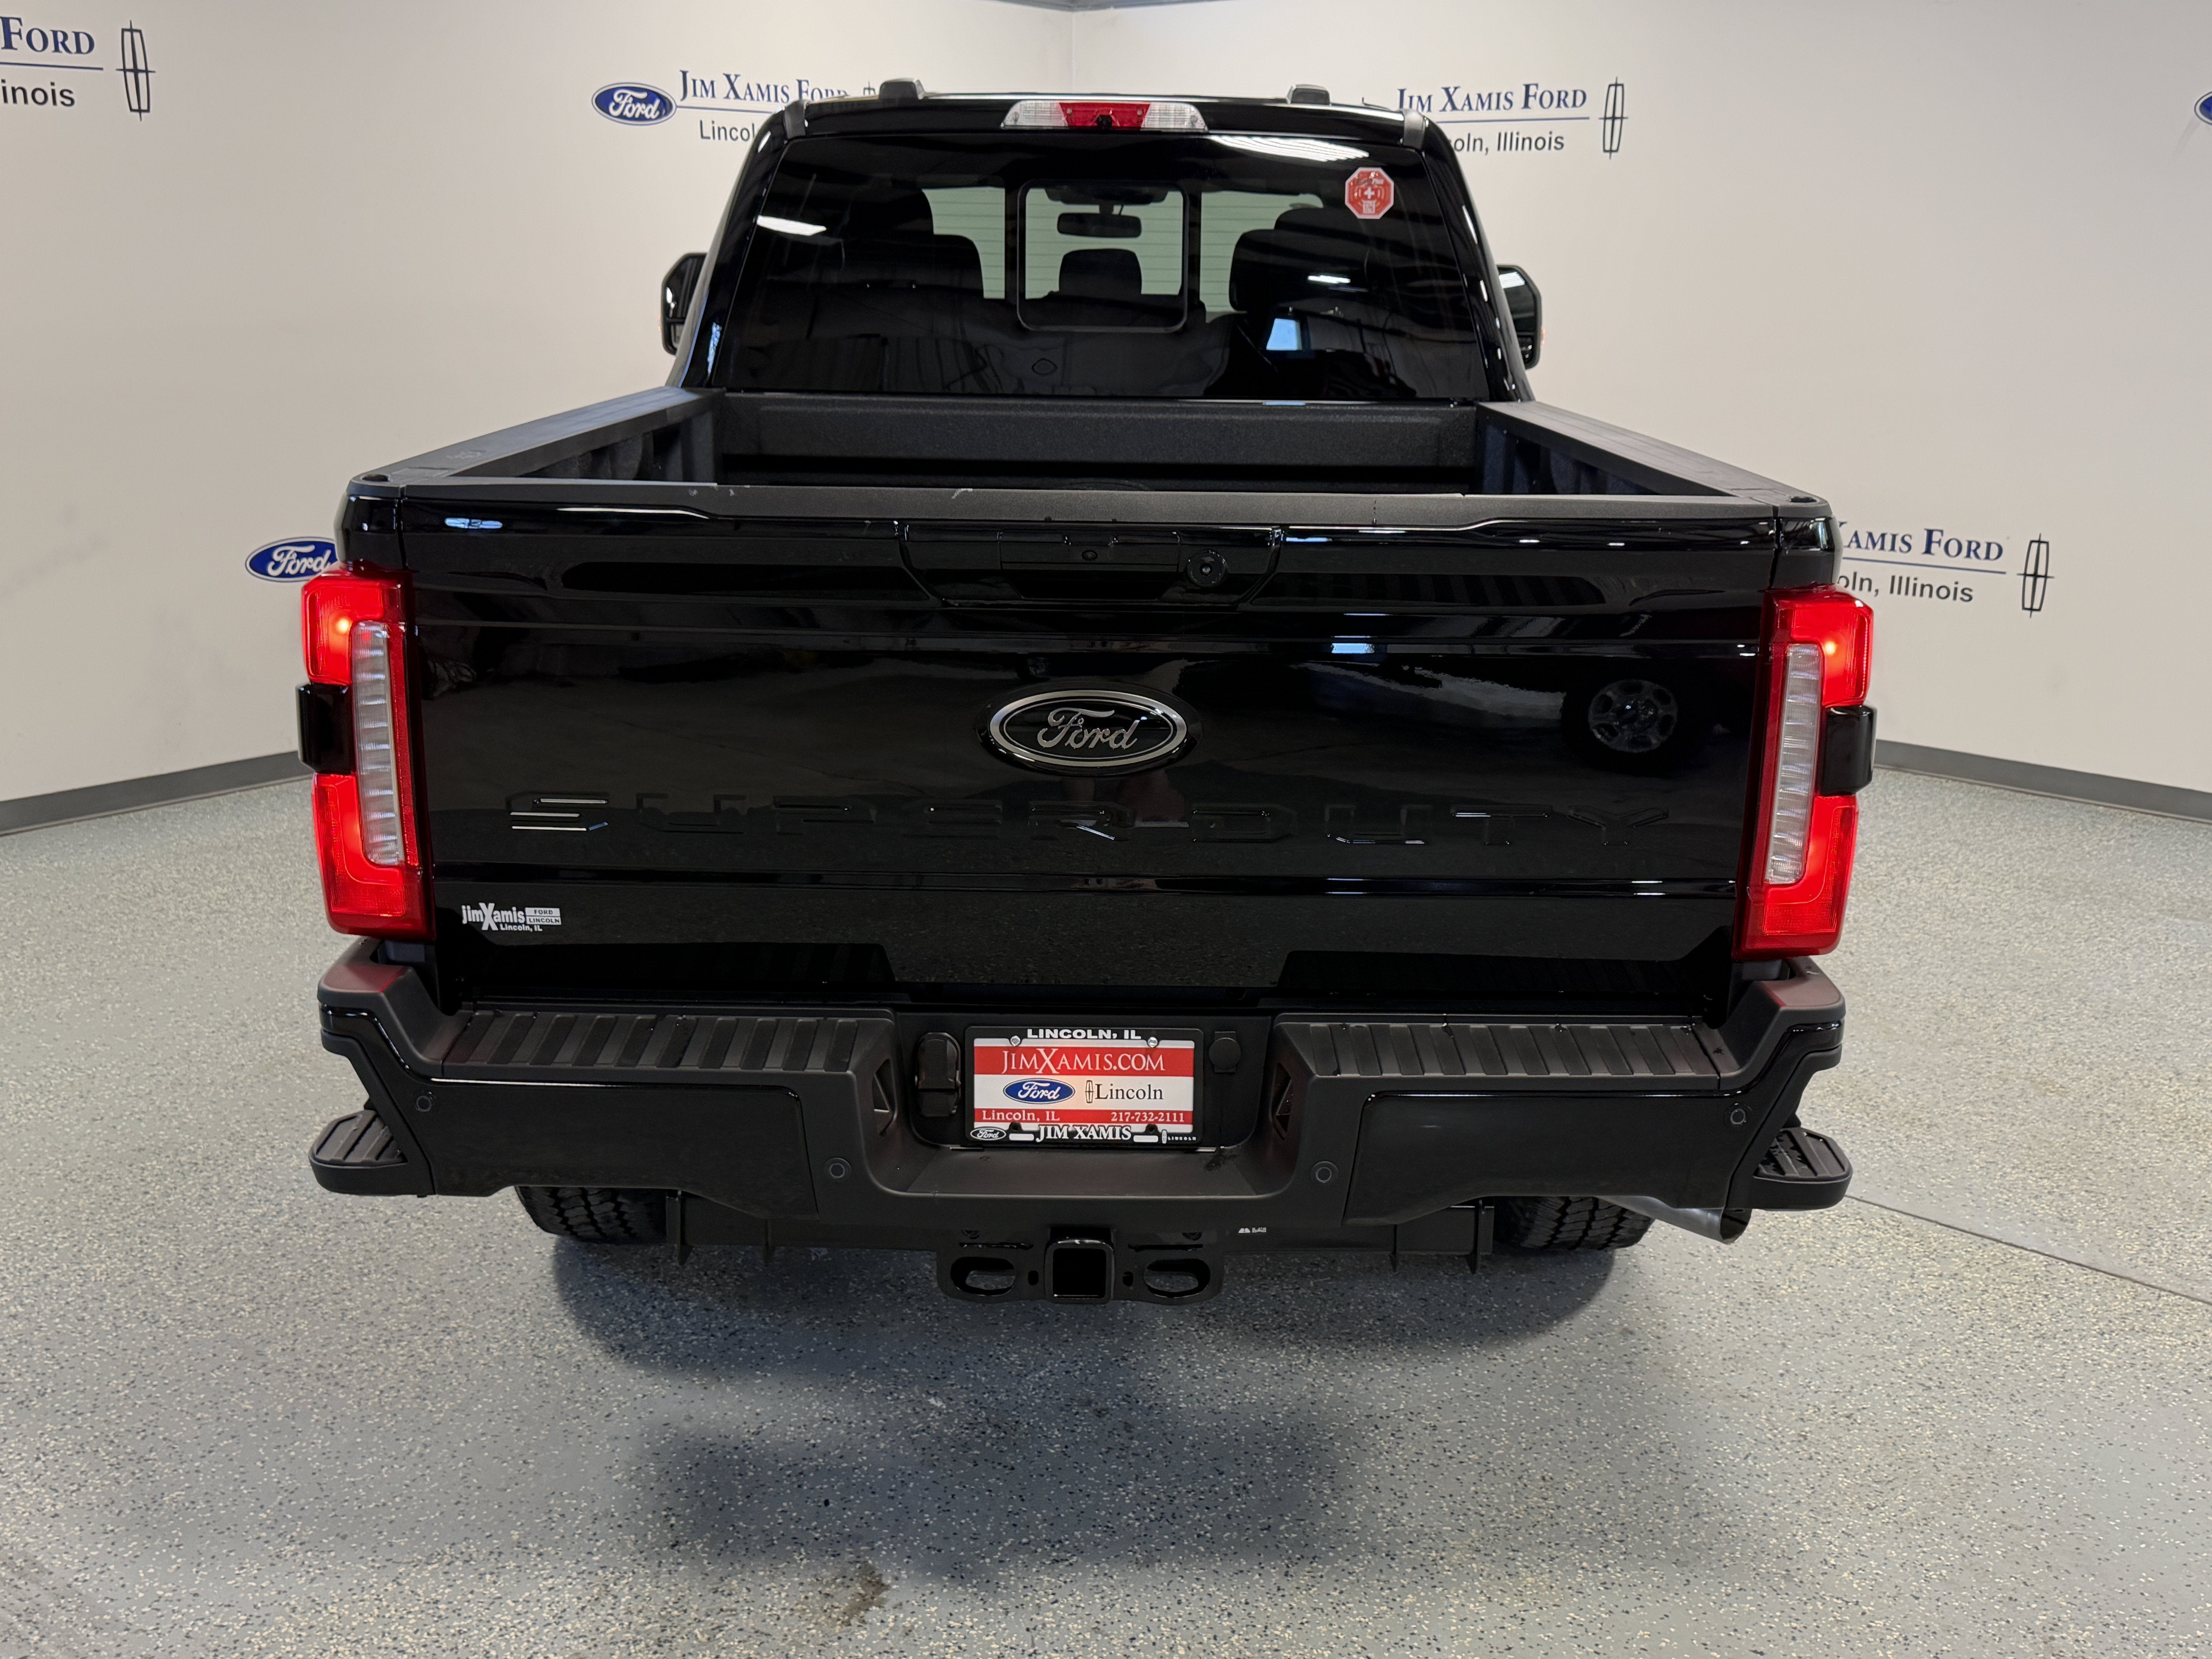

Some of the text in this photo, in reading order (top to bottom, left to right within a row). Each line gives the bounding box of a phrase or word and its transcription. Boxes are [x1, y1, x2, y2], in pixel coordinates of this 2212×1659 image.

[1, 79, 75, 107] inois
[680, 70, 716, 101] JIM
[723, 73, 790, 103] XAMIS
[1439, 86, 1513, 112] XAMIS
[1521, 83, 1587, 110] FORD
[609, 89, 660, 119] Ford
[700, 120, 755, 142] Lincol
[1497, 131, 1564, 151] Illinois
[1838, 521, 2003, 561] AMIS FORD
[268, 544, 331, 576] Ford
[1889, 575, 1973, 602] Illinois
[1037, 707, 1138, 749] Ford
[1027, 1029, 1142, 1039] LINCOLN, IL
[1017, 1081, 1164, 1100] Ford Lincoln
[982, 1110, 1060, 1122] Lincoln, IL
[1111, 1111, 1185, 1122] 217-732-2111
[976, 1129, 1000, 1139] Ford
[1036, 1125, 1132, 1142] JIM XAMIS
